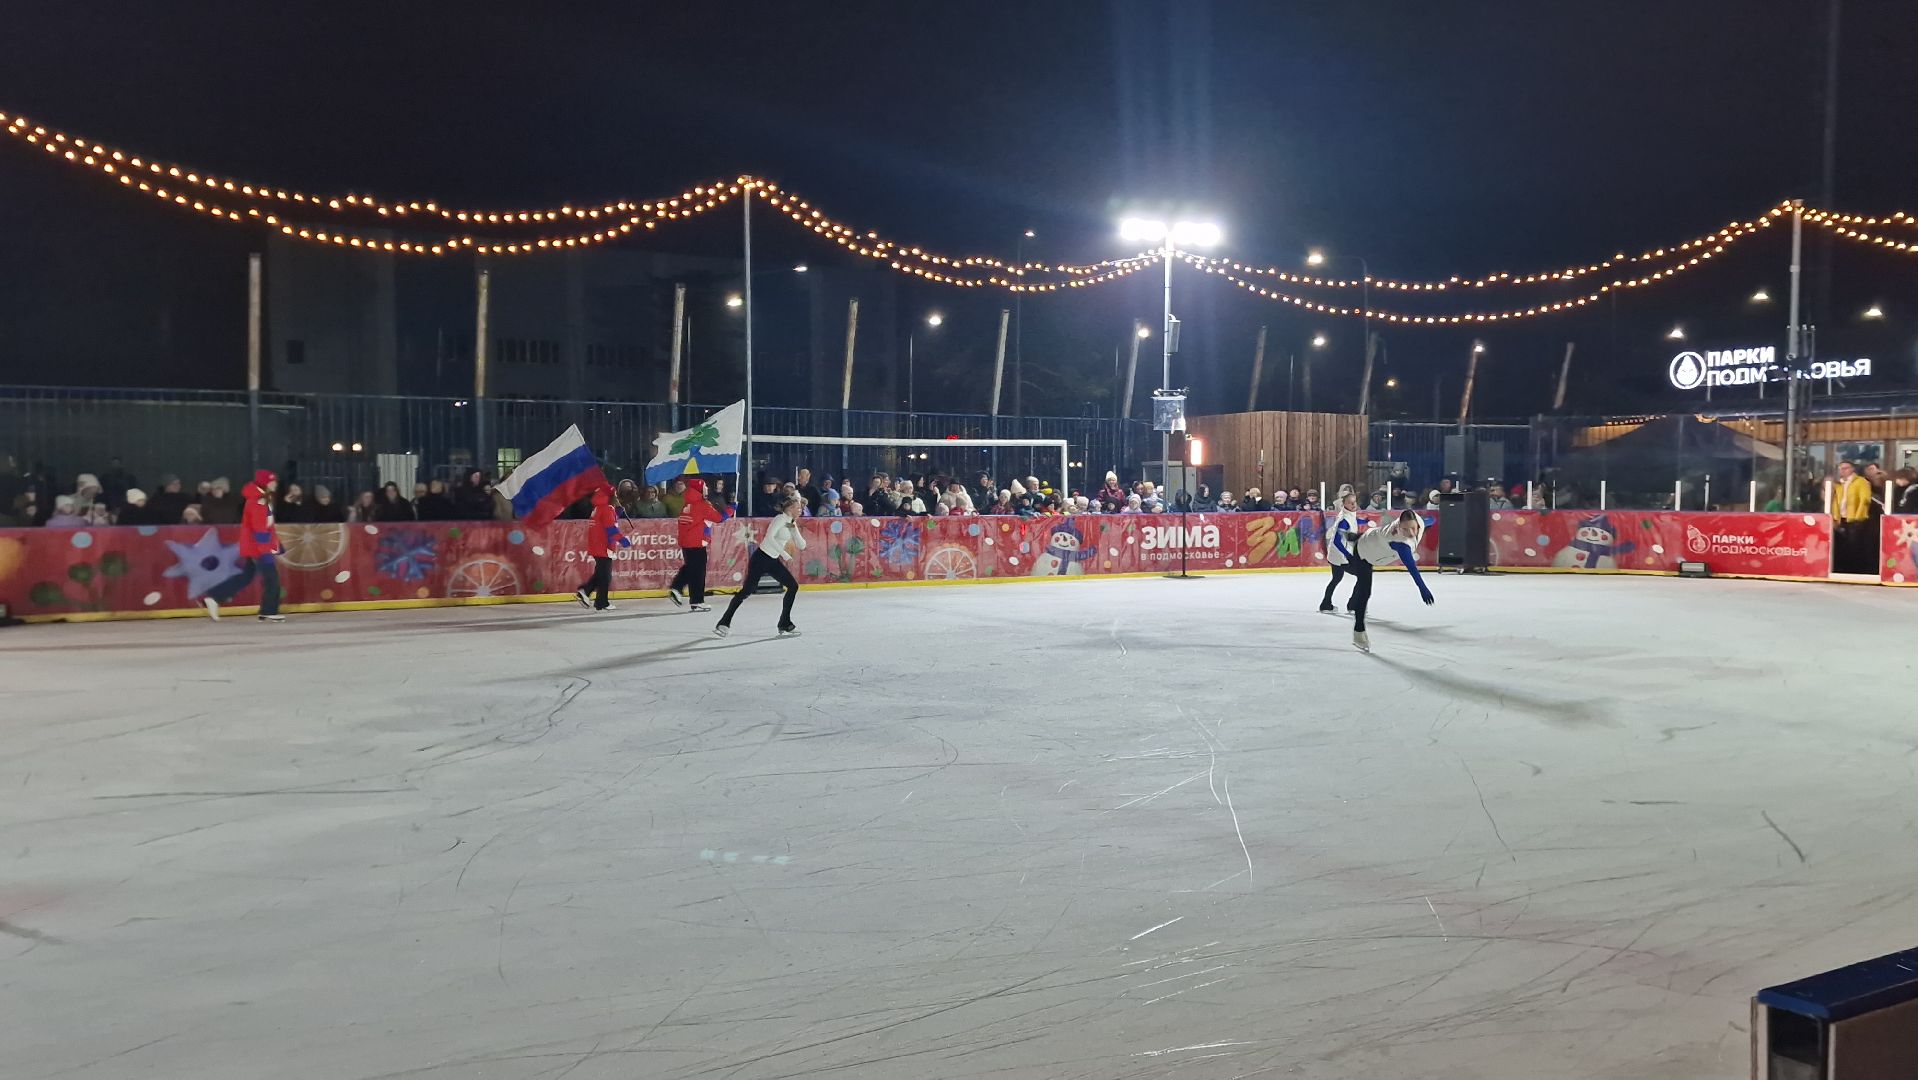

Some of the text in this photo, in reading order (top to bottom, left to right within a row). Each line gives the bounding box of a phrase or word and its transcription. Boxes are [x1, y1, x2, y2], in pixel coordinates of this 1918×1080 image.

[1707, 346, 1775, 367] ПАРКИ
[1707, 358, 1872, 387] ПОДМОВЬЯ
[1712, 534, 1754, 545] ПАРКИ
[564, 550, 575, 562] С
[1712, 544, 1808, 556] ПОДМОСКОВЬЯ
